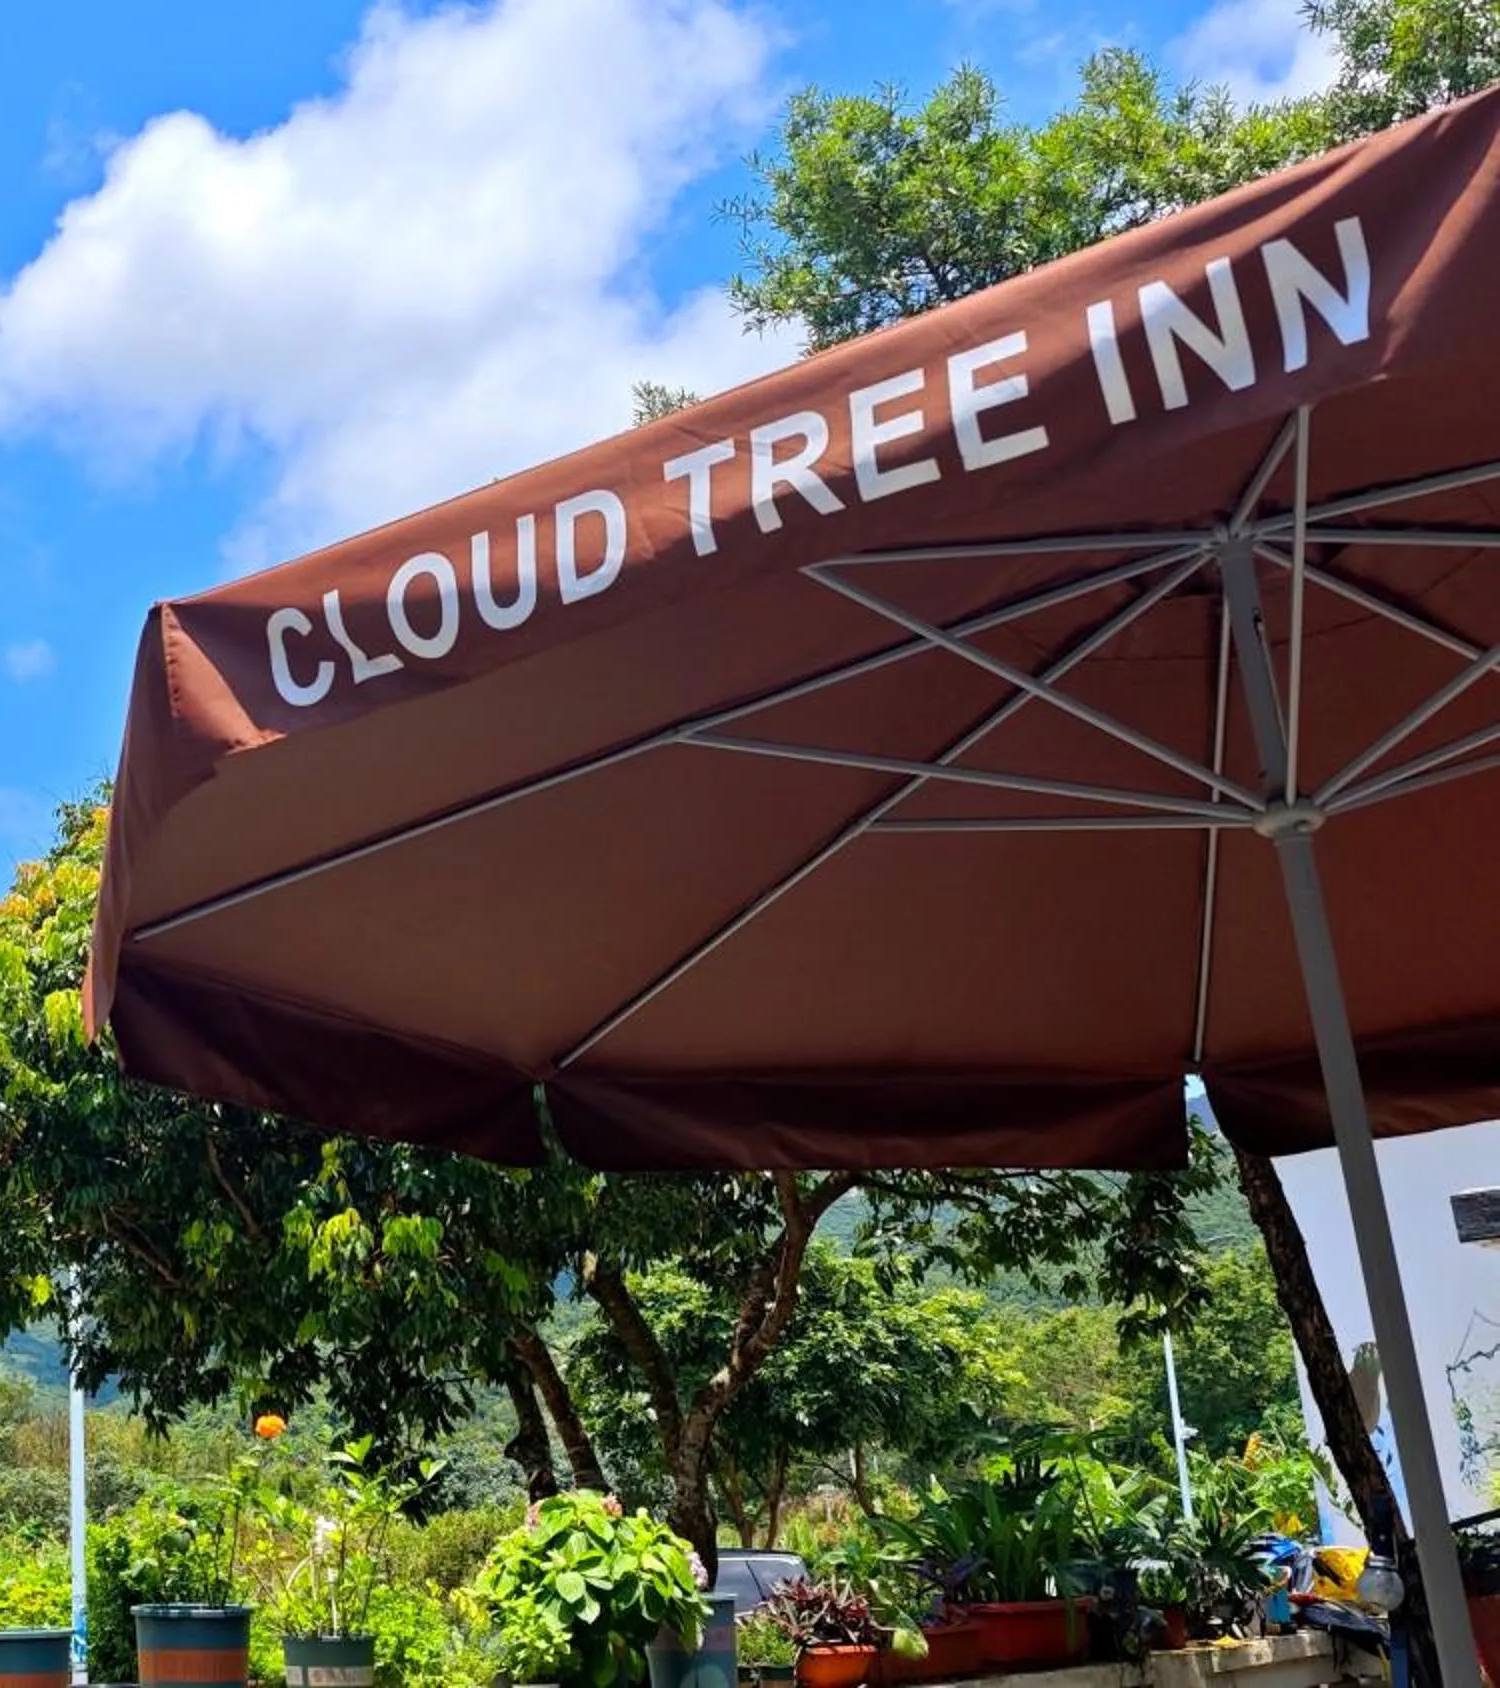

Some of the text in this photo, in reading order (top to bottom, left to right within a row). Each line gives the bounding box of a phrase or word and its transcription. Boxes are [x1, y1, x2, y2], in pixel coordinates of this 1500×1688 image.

[266, 216, 1371, 706] CLOUD TREE INN
